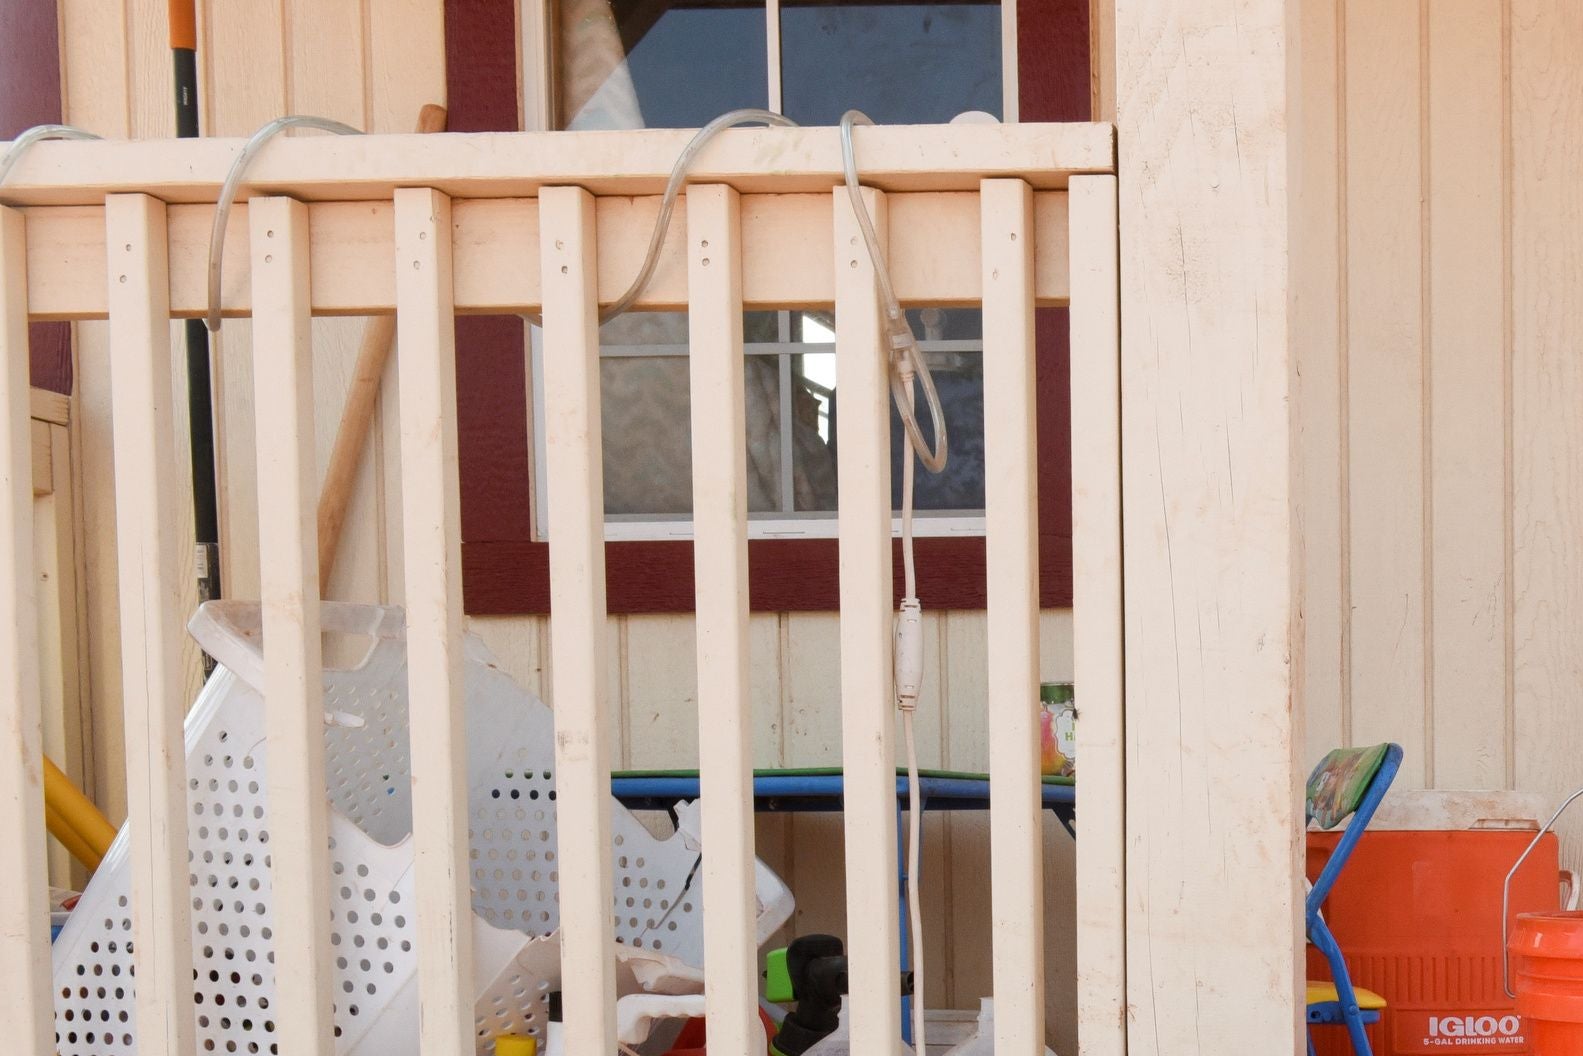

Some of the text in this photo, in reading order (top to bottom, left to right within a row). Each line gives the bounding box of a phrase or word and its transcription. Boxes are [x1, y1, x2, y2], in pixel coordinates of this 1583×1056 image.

[1429, 1015, 1520, 1037] IGLOO
[1423, 1036, 1524, 1045] 5-GAL DRINKING WATER
